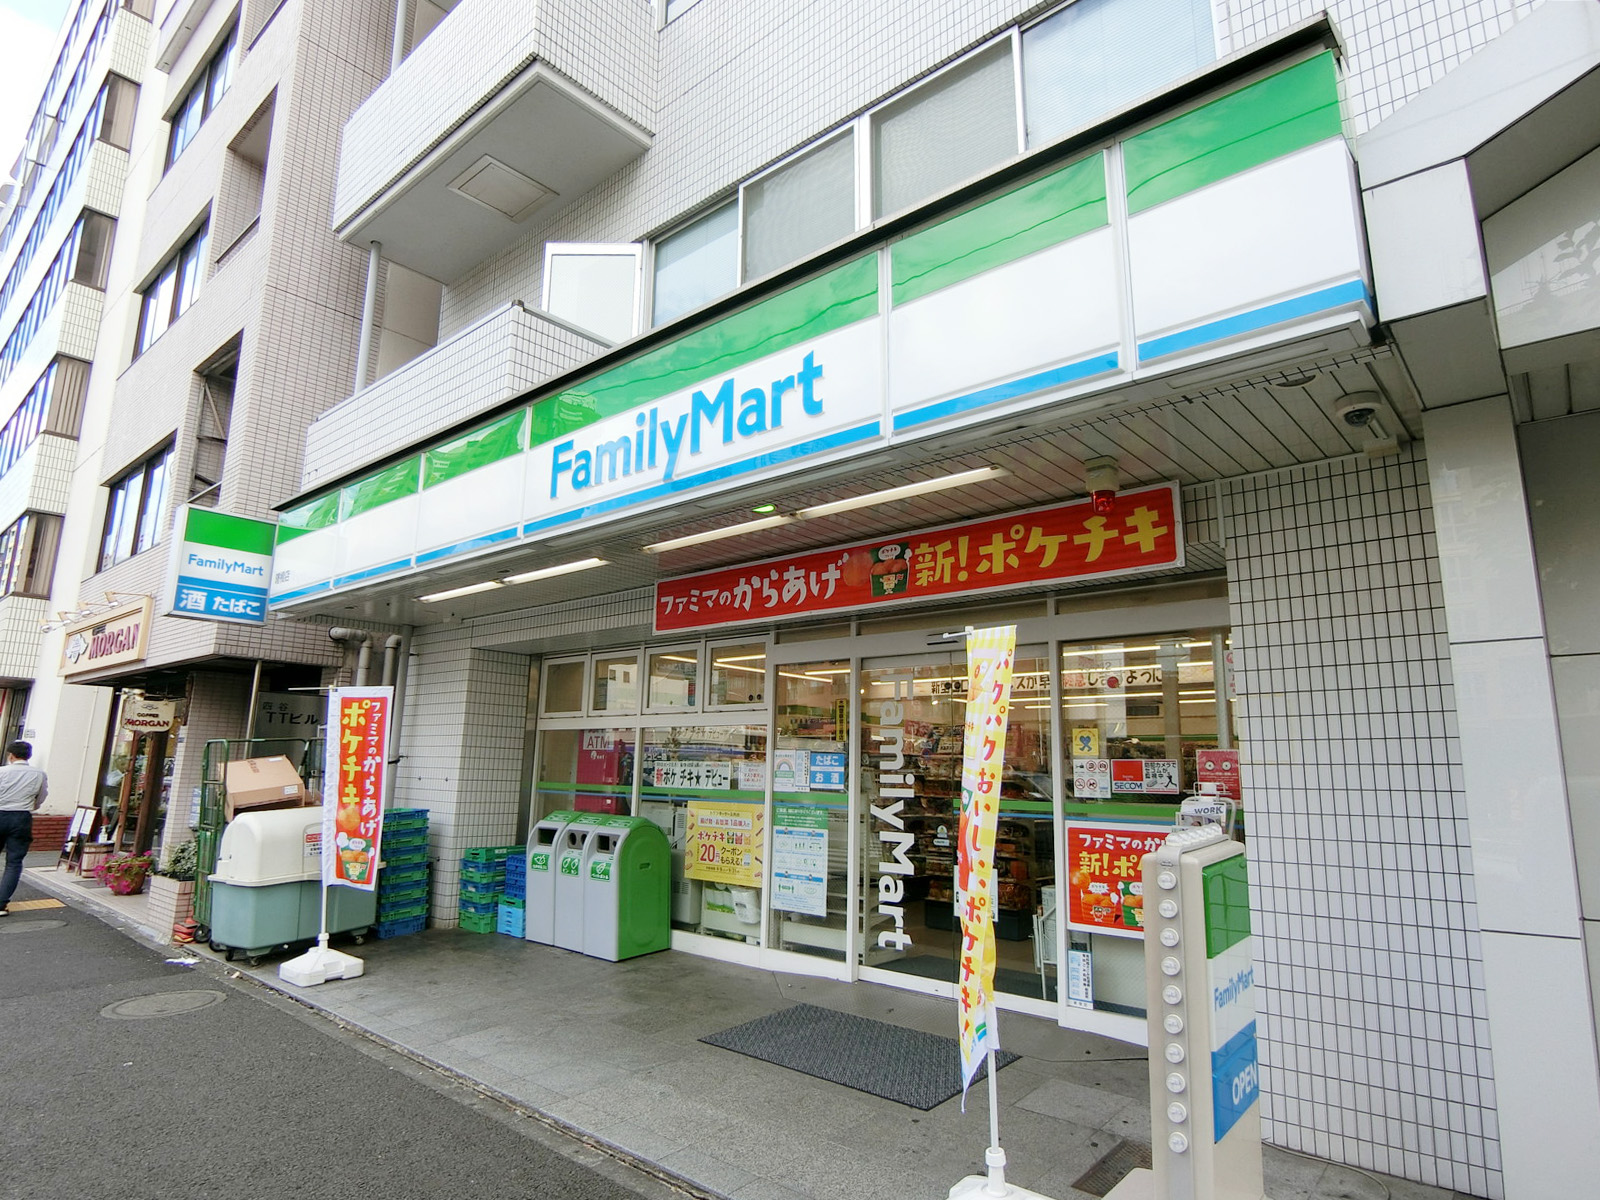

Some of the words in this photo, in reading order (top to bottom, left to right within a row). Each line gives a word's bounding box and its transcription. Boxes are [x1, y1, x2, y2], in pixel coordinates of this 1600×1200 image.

[550, 350, 824, 499] FamilyMart
[187, 553, 264, 576] FamilyMart
[660, 552, 849, 613] ファミマのからあげ
[179, 588, 208, 611] 酒
[212, 596, 261, 616] たばこ
[87, 623, 141, 660] MORGAN
[125, 719, 170, 729] MORGAN
[342, 699, 370, 805] ポケチキ
[586, 735, 610, 749] ATM
[360, 701, 382, 838] ファミマのからあげ
[815, 755, 840, 766] たばこ
[1114, 782, 1143, 790] SECOM
[870, 674, 915, 951] FamilyMart
[1194, 806, 1223, 815] WORK
[697, 830, 725, 843] ポケチキ
[1214, 965, 1254, 1012] FamilyMart
[1232, 1061, 1257, 1106] OPEN
